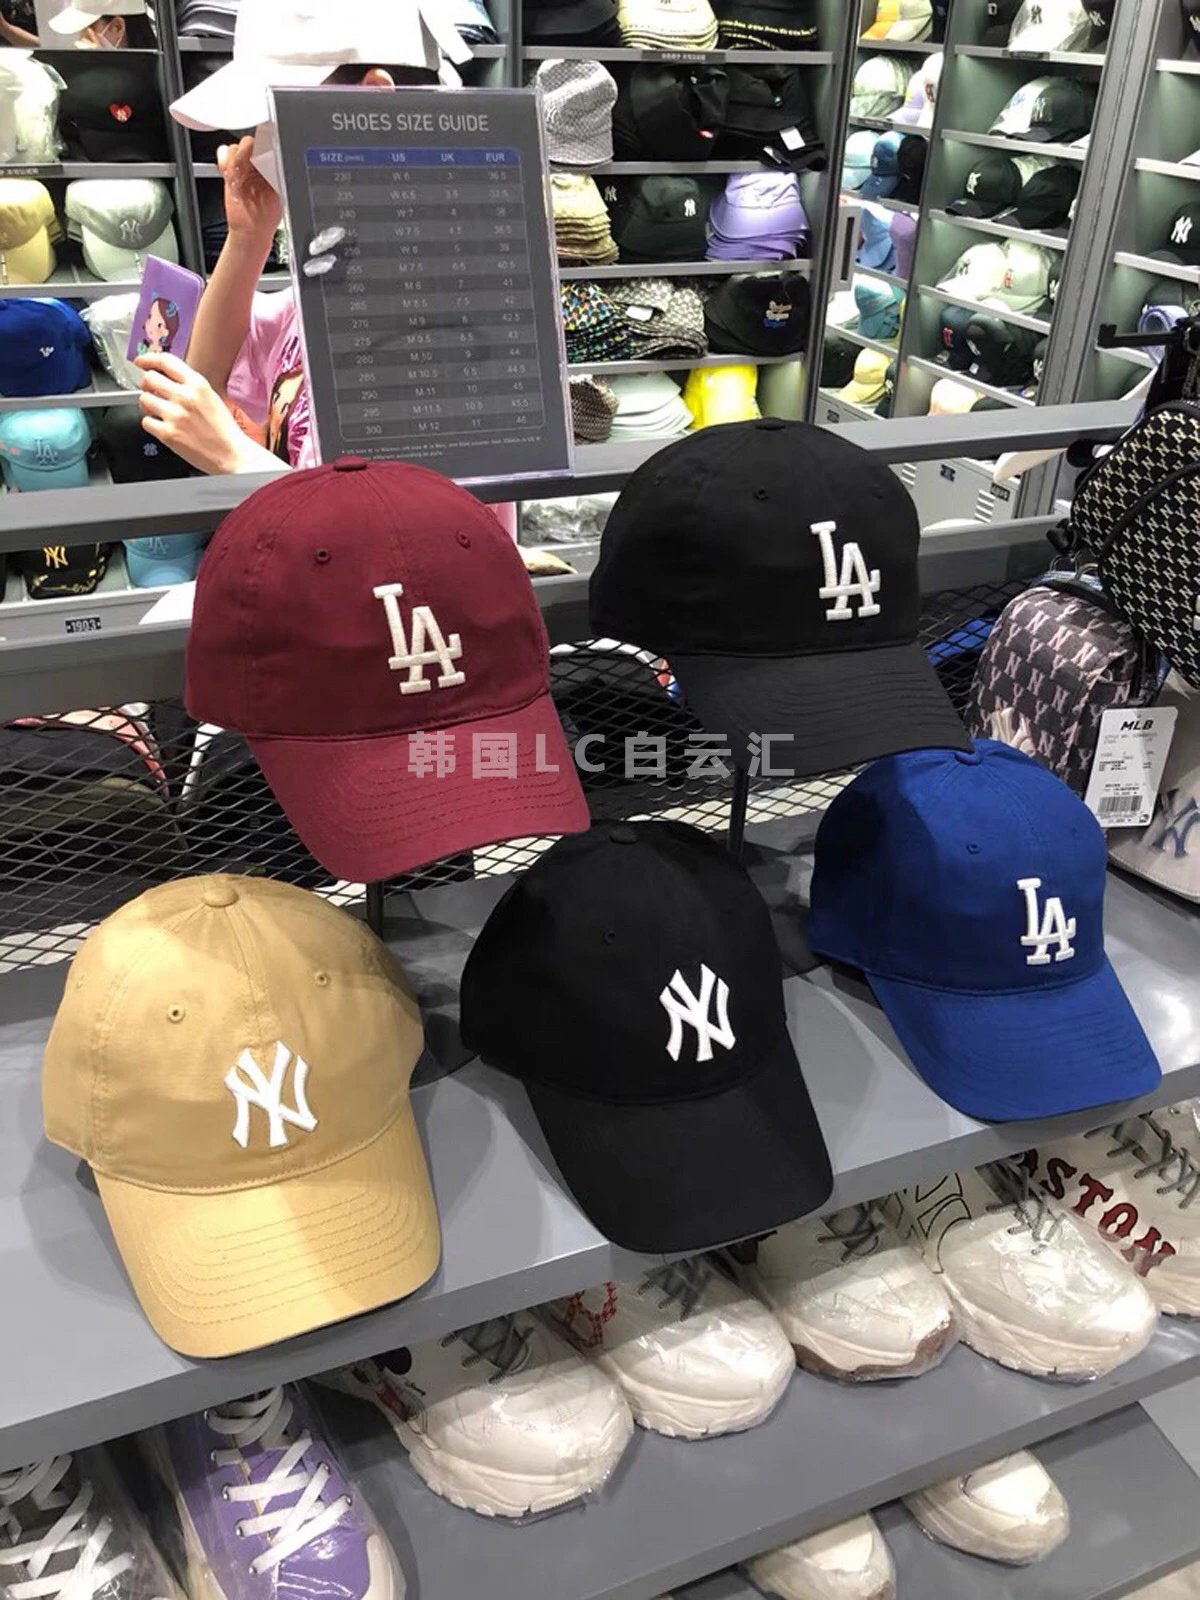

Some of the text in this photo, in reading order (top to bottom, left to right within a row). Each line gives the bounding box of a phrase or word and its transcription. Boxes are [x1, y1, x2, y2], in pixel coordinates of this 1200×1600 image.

[332, 113, 489, 132] SHOES SIZE GUIDE
[320, 152, 343, 163] SIZE
[391, 152, 406, 163] US
[440, 152, 455, 162] UK
[486, 152, 505, 162] EUR
[1170, 216, 1193, 244] NY
[43, 546, 69, 568] NY
[810, 520, 880, 621] LA
[71, 618, 97, 633] 1903
[373, 583, 466, 695] LA
[1120, 719, 1154, 731] MLB
[1017, 877, 1076, 965] LA
[659, 963, 736, 1062] NY
[223, 1040, 319, 1148] NY
